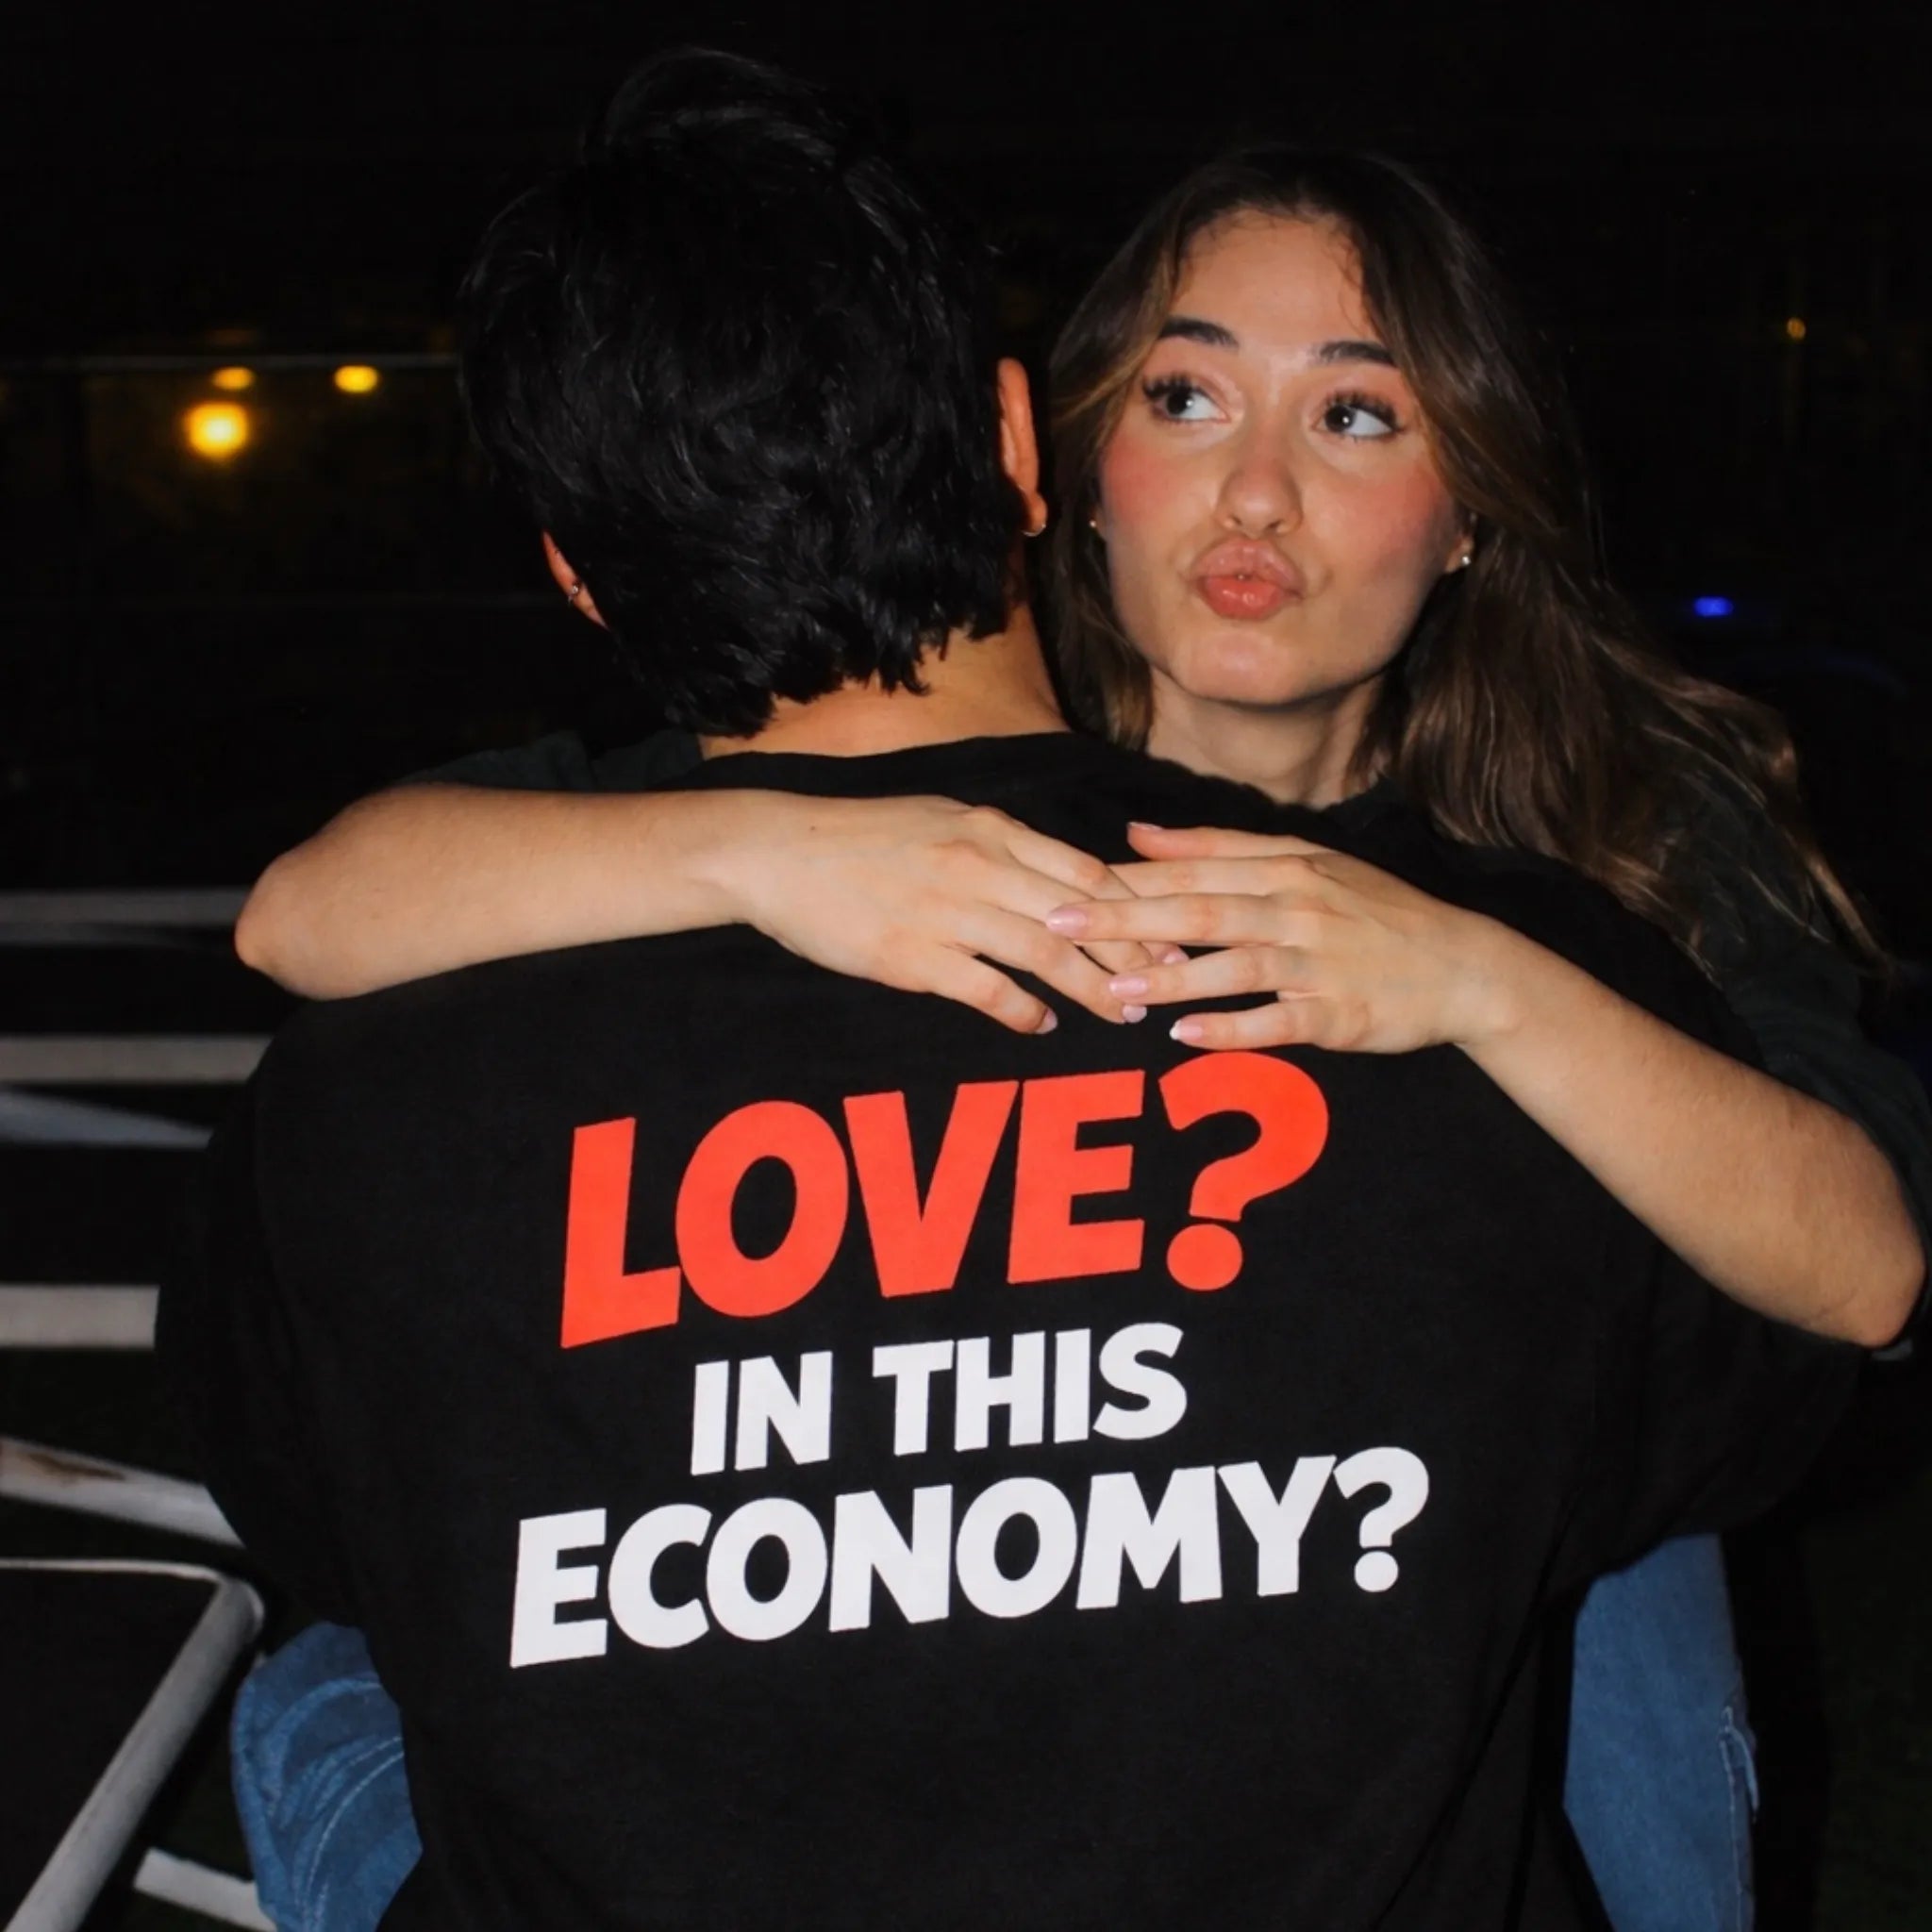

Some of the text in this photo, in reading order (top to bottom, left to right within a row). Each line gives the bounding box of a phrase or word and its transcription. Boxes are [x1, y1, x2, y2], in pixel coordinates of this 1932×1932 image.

[561, 1052, 1329, 1349] LOVE?
[691, 1323, 1188, 1476] IN THIS
[509, 1446, 1429, 1669] ECONOMY?
